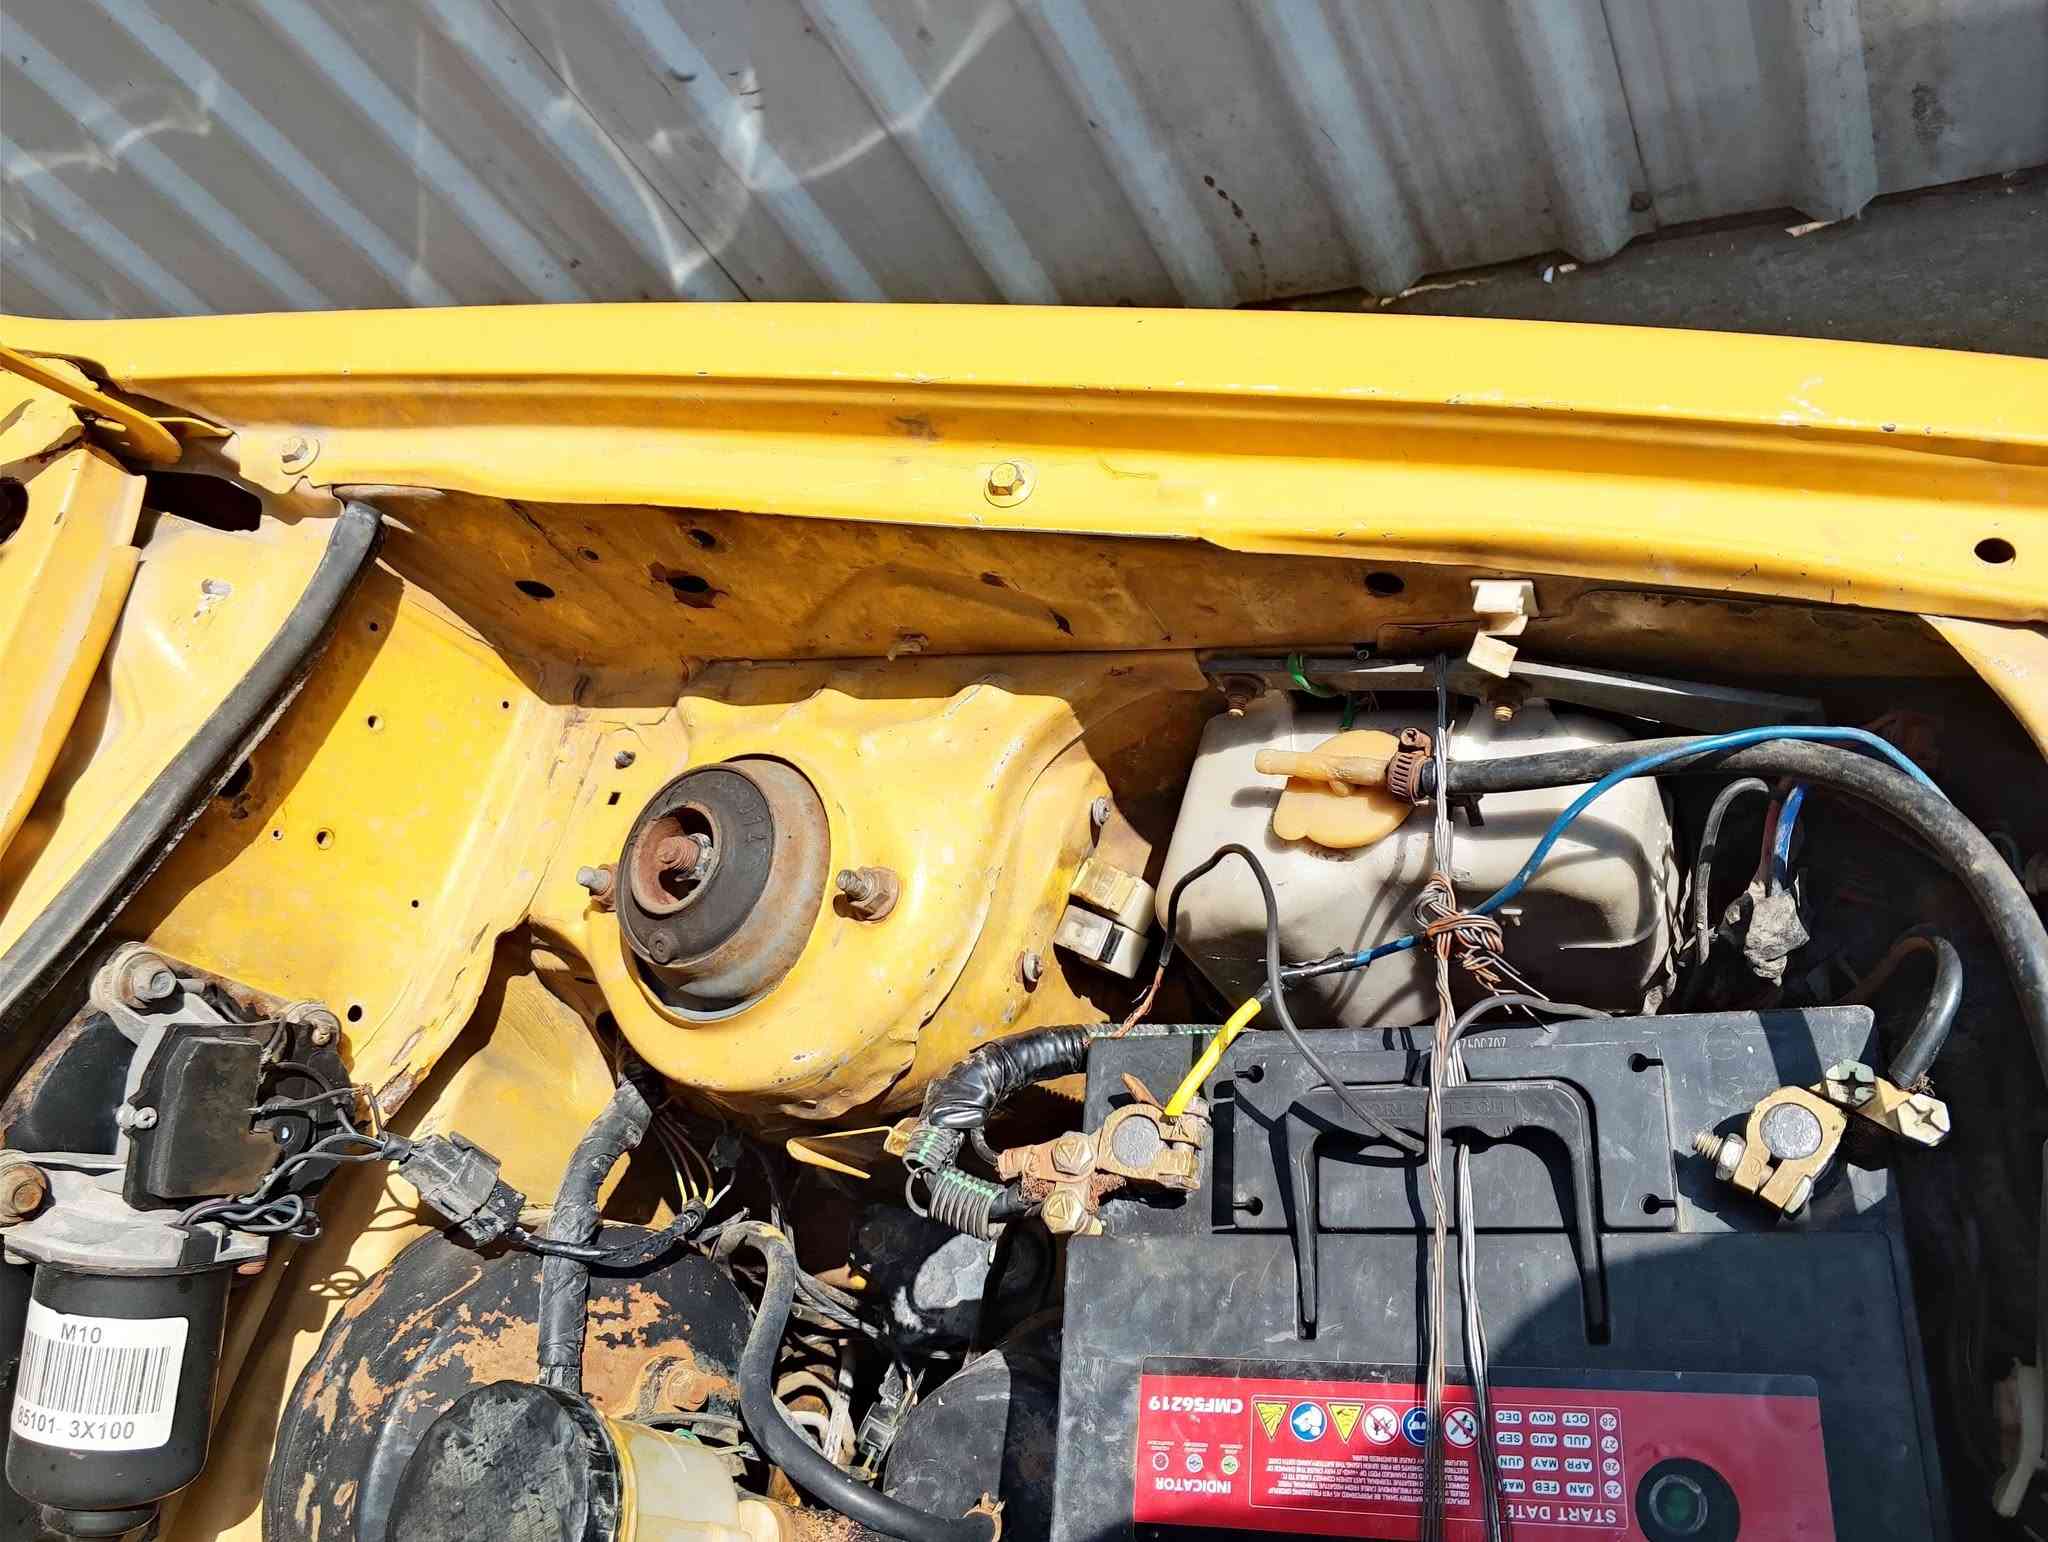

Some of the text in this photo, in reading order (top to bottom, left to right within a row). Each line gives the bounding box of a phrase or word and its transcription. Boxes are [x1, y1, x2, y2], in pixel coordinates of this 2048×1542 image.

[61, 1323, 102, 1344] M10
[1149, 1396, 1243, 1414] CMF56219
[1498, 1412, 1520, 1422] DEC
[1532, 1414, 1554, 1422] NOV
[1565, 1414, 1588, 1424] OCT
[1498, 1434, 1616, 1449] 27 JUL AUG SEP
[1500, 1457, 1522, 1467] JUN
[1534, 1458, 1556, 1467] MAY
[1567, 1461, 1590, 1470] APR
[1155, 1477, 1232, 1493] INDICATOR
[1535, 1482, 1557, 1492] FEB
[1569, 1484, 1592, 1494] JAN
[1606, 1485, 1618, 1495] 25
[1557, 1506, 1616, 1523] START
